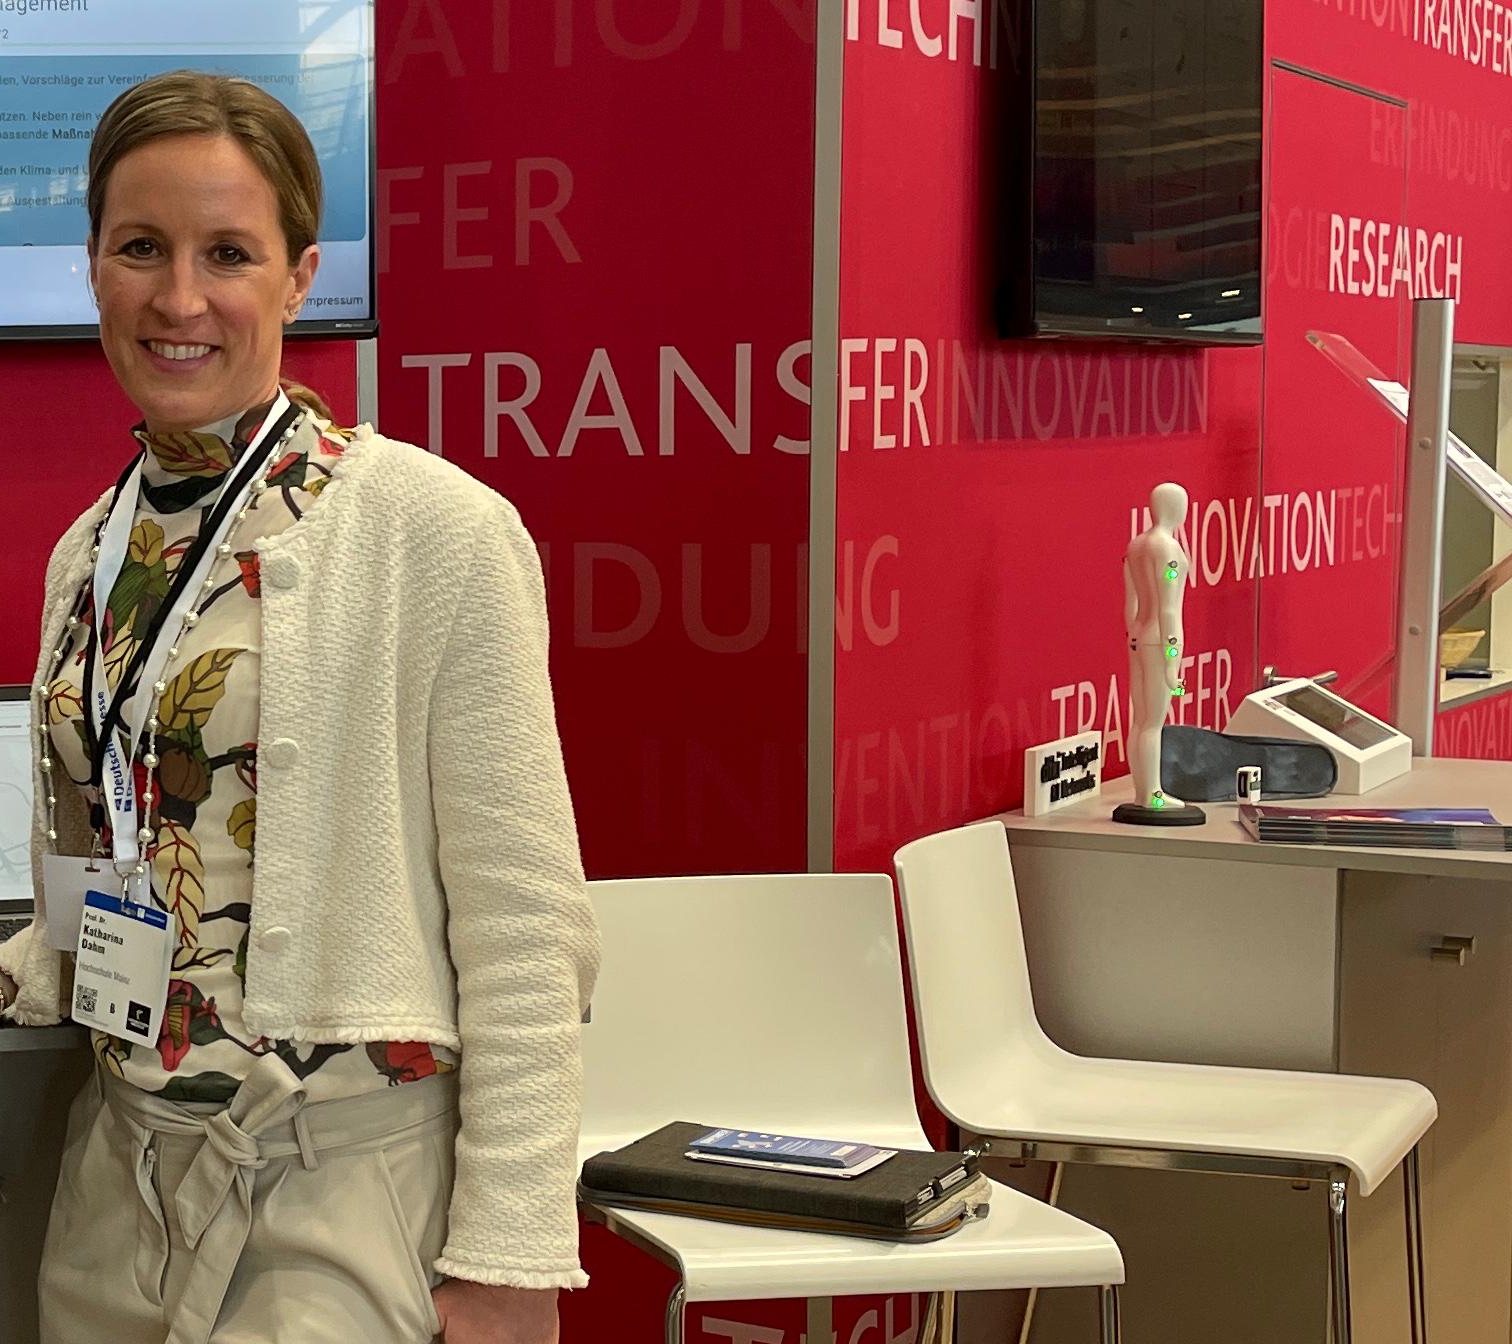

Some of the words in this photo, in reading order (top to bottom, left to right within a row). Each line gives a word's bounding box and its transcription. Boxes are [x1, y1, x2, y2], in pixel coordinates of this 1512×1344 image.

[21, 75, 85, 87] Vorschläge
[87, 76, 106, 85] zur
[32, 111, 68, 122] Neben
[70, 111, 92, 122] rein
[57, 164, 79, 175] und
[1329, 213, 1463, 305] RESEARCH
[303, 294, 364, 308] mpressum
[97, 691, 107, 720] esse
[104, 736, 124, 796] Deutsch
[83, 924, 124, 946] Katharina
